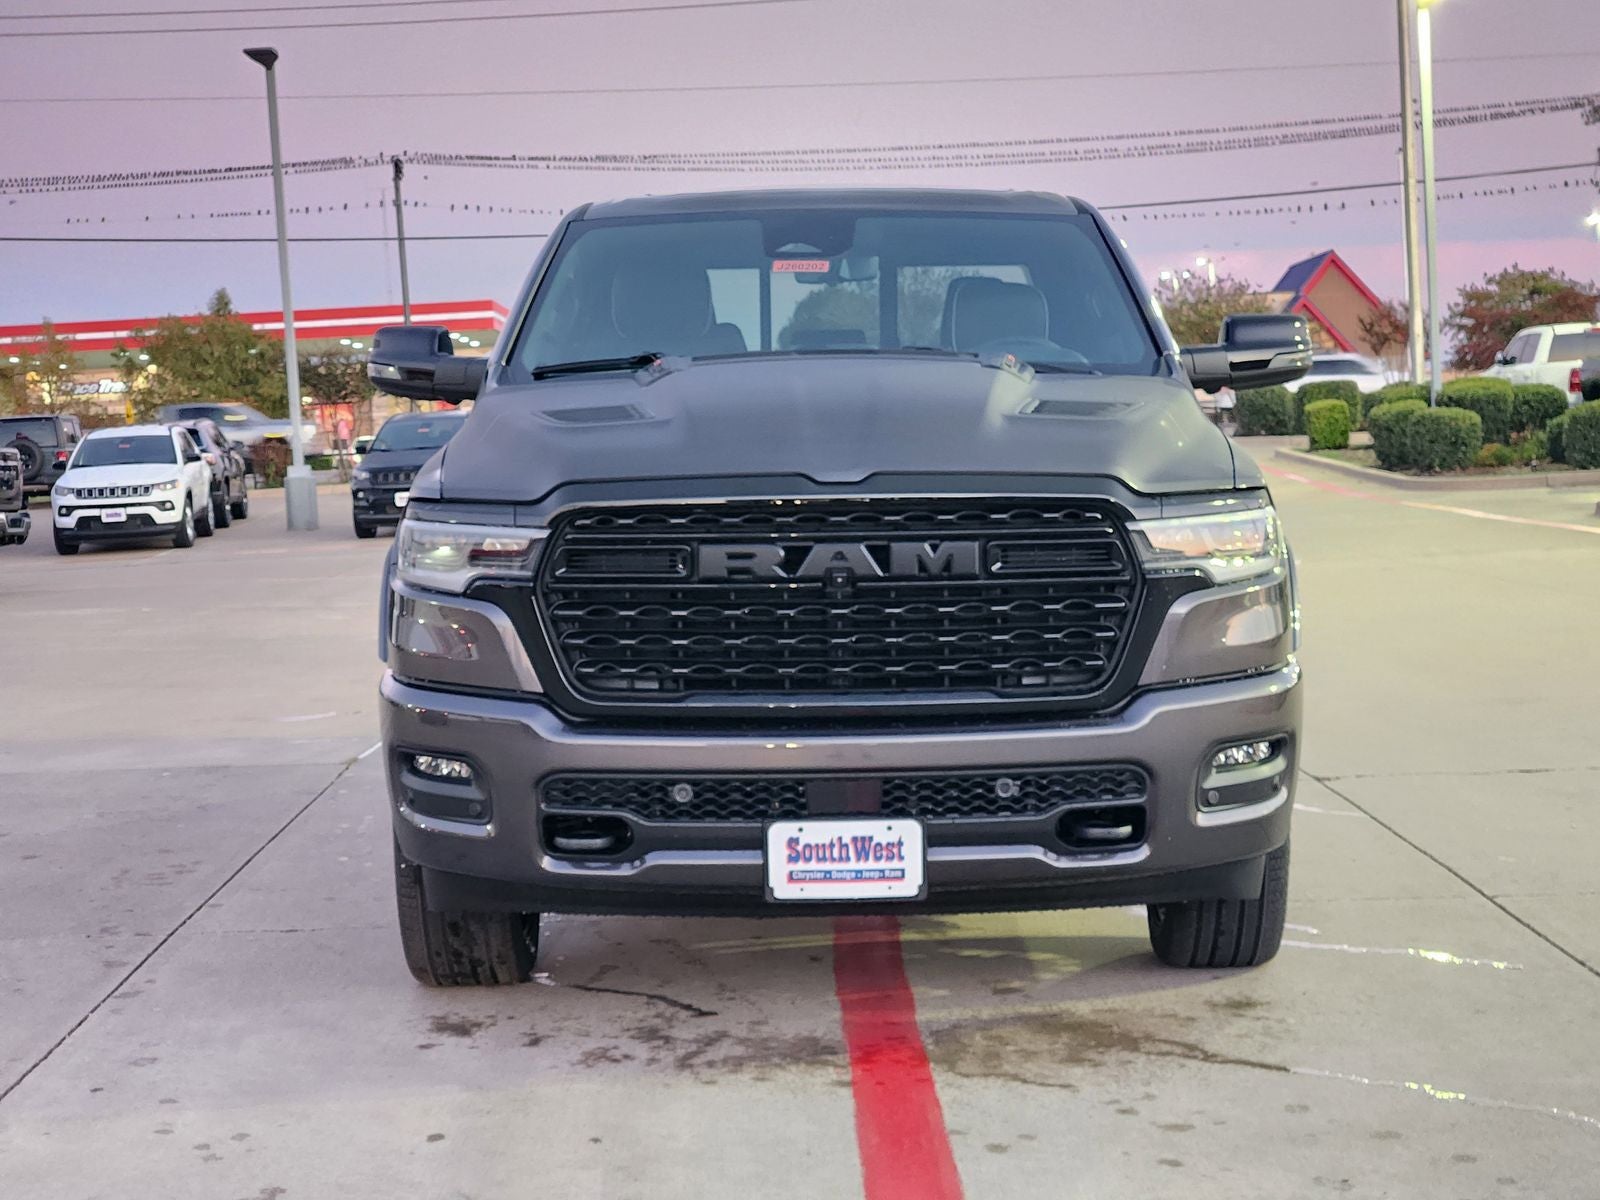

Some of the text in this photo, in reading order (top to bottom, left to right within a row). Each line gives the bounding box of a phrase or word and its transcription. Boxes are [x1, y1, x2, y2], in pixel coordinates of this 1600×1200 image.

[698, 541, 980, 578] RAM
[786, 835, 905, 865] SouthWest
[792, 869, 903, 880] Chrysler Dodge Jeep Ram
